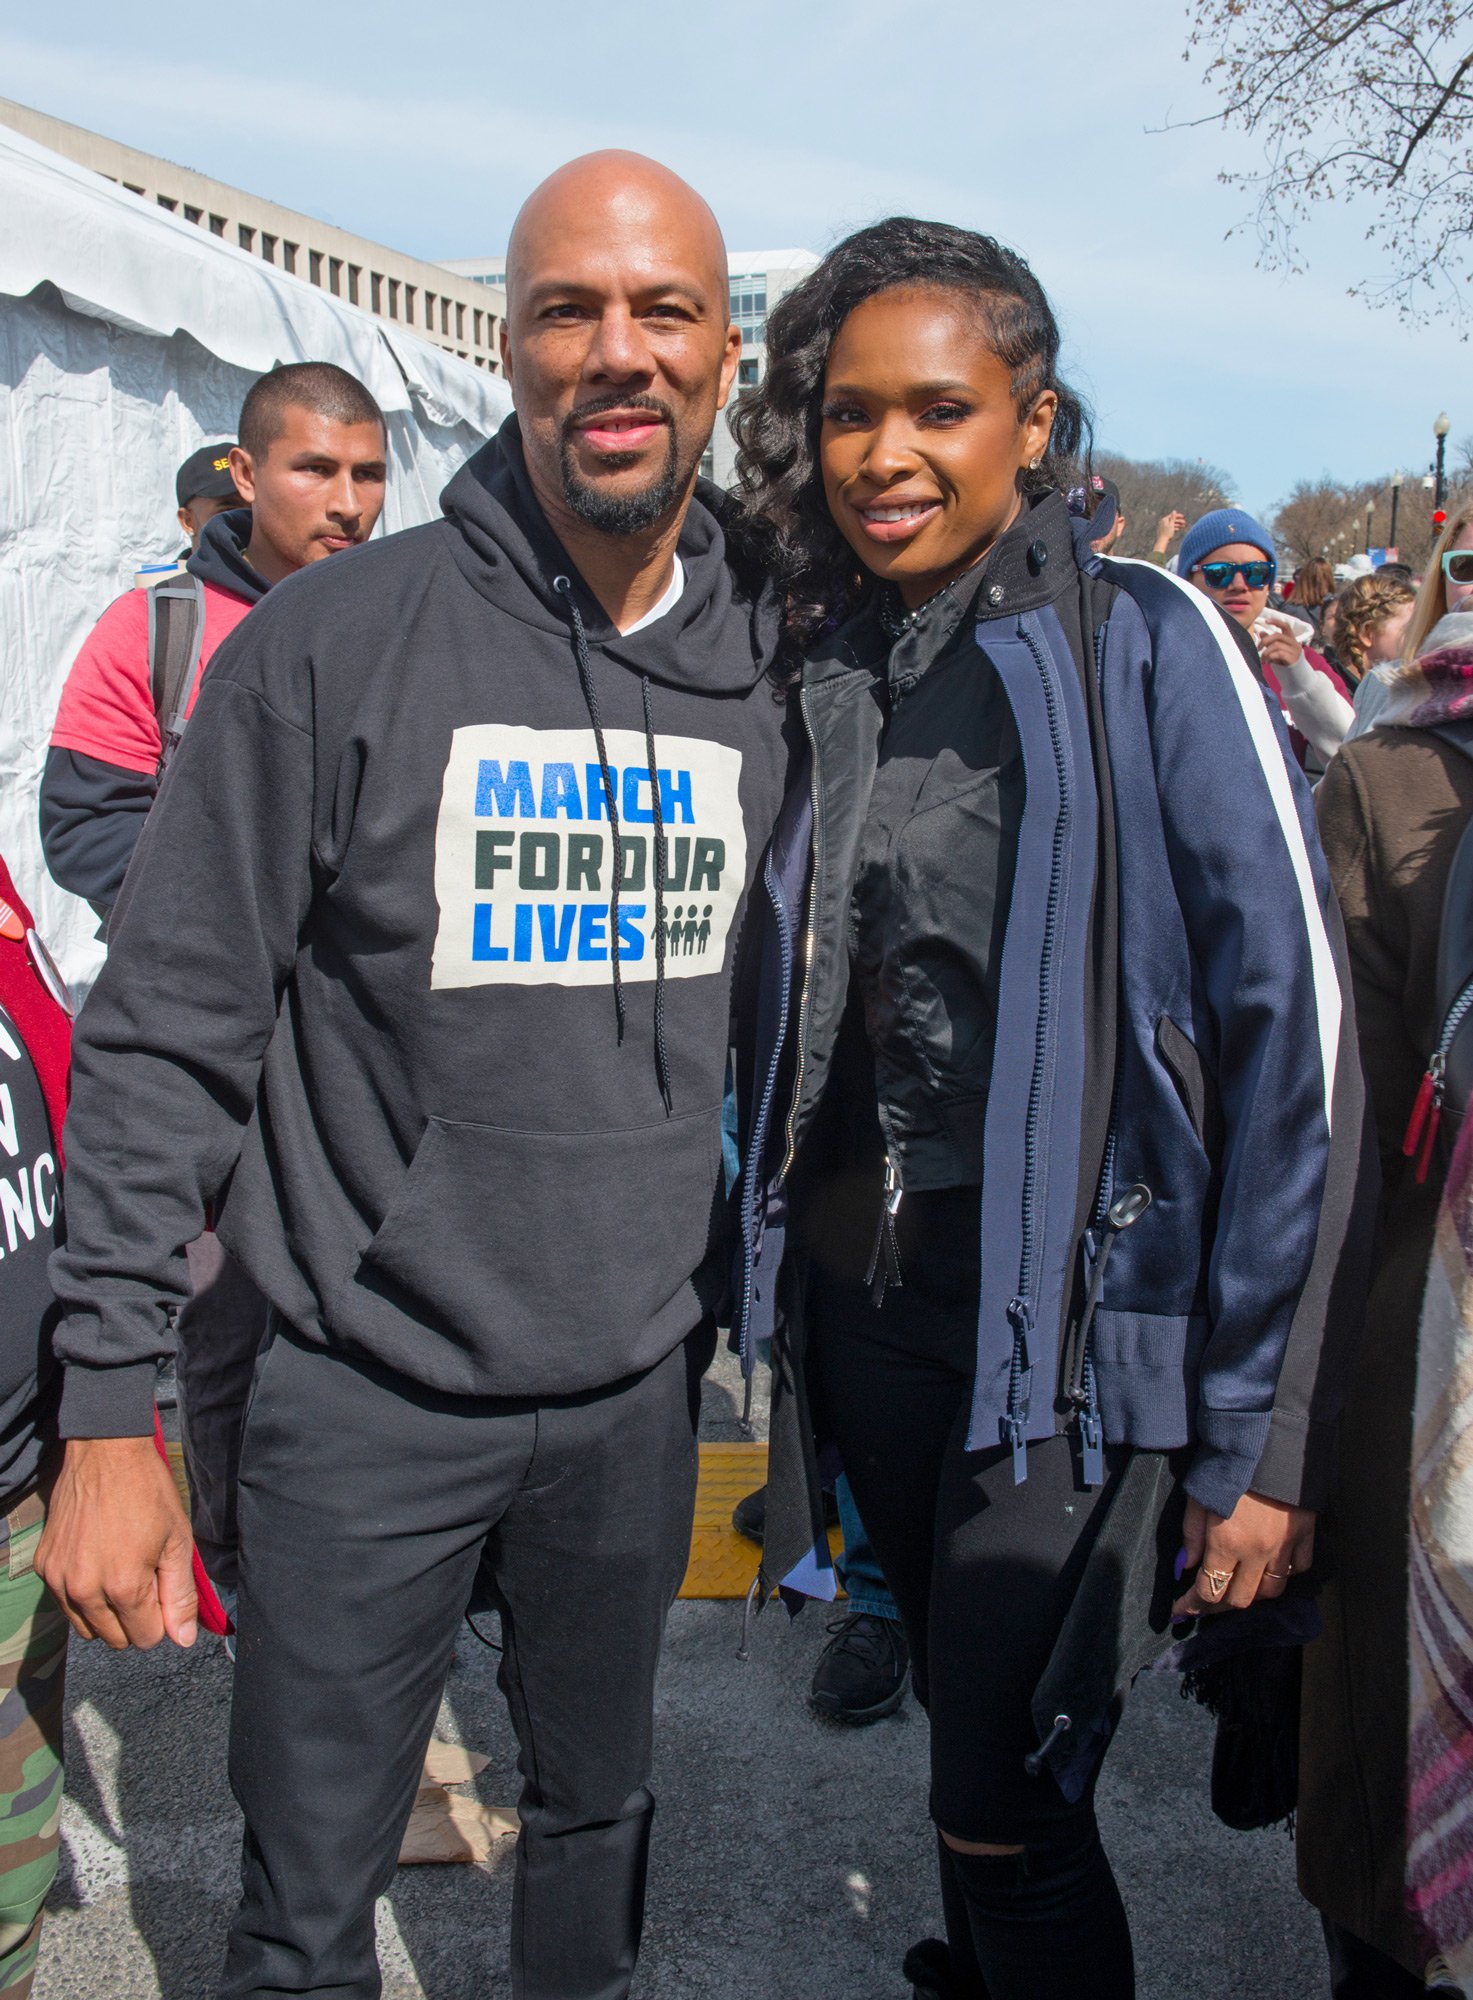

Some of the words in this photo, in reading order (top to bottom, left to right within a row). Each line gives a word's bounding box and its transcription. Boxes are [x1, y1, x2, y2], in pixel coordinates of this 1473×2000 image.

[474, 759, 696, 825] MARCH
[474, 830, 604, 892] FOR
[611, 835, 726, 892] OUR
[472, 903, 647, 963] LIVES
[0, 1151, 56, 1260] NC
